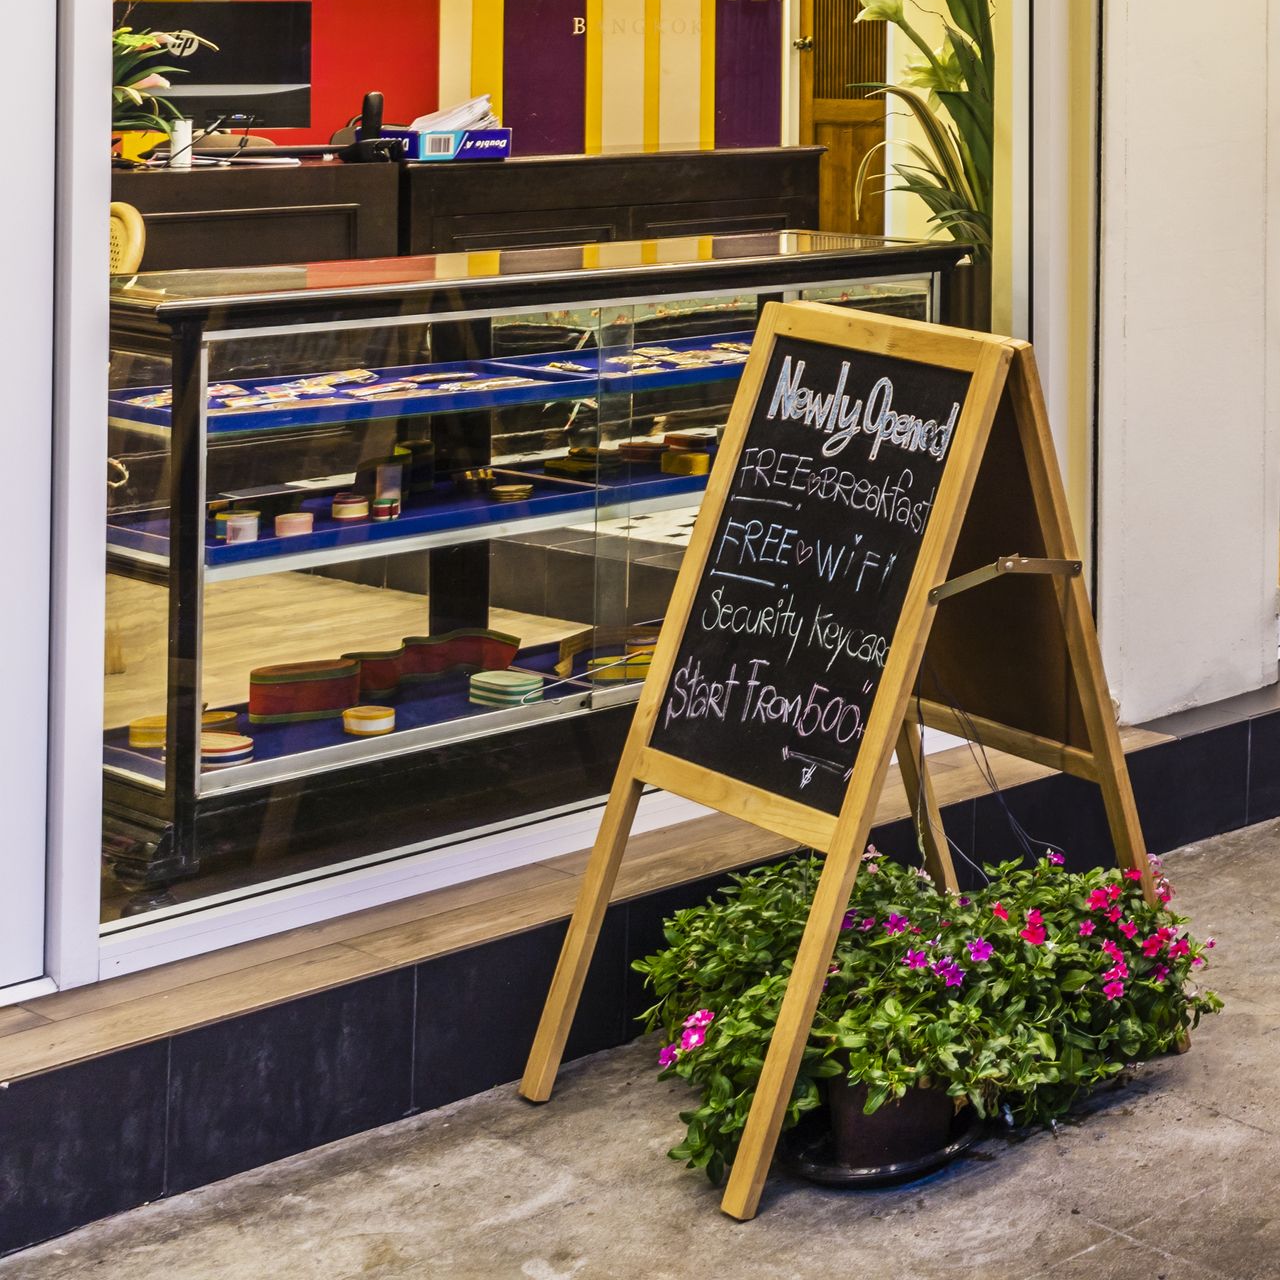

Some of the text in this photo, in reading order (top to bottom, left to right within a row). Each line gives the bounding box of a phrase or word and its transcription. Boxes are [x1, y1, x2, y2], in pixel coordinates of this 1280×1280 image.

[767, 355, 960, 462] Newly Opened
[740, 448, 814, 491] FREE
[716, 516, 798, 565] FREE
